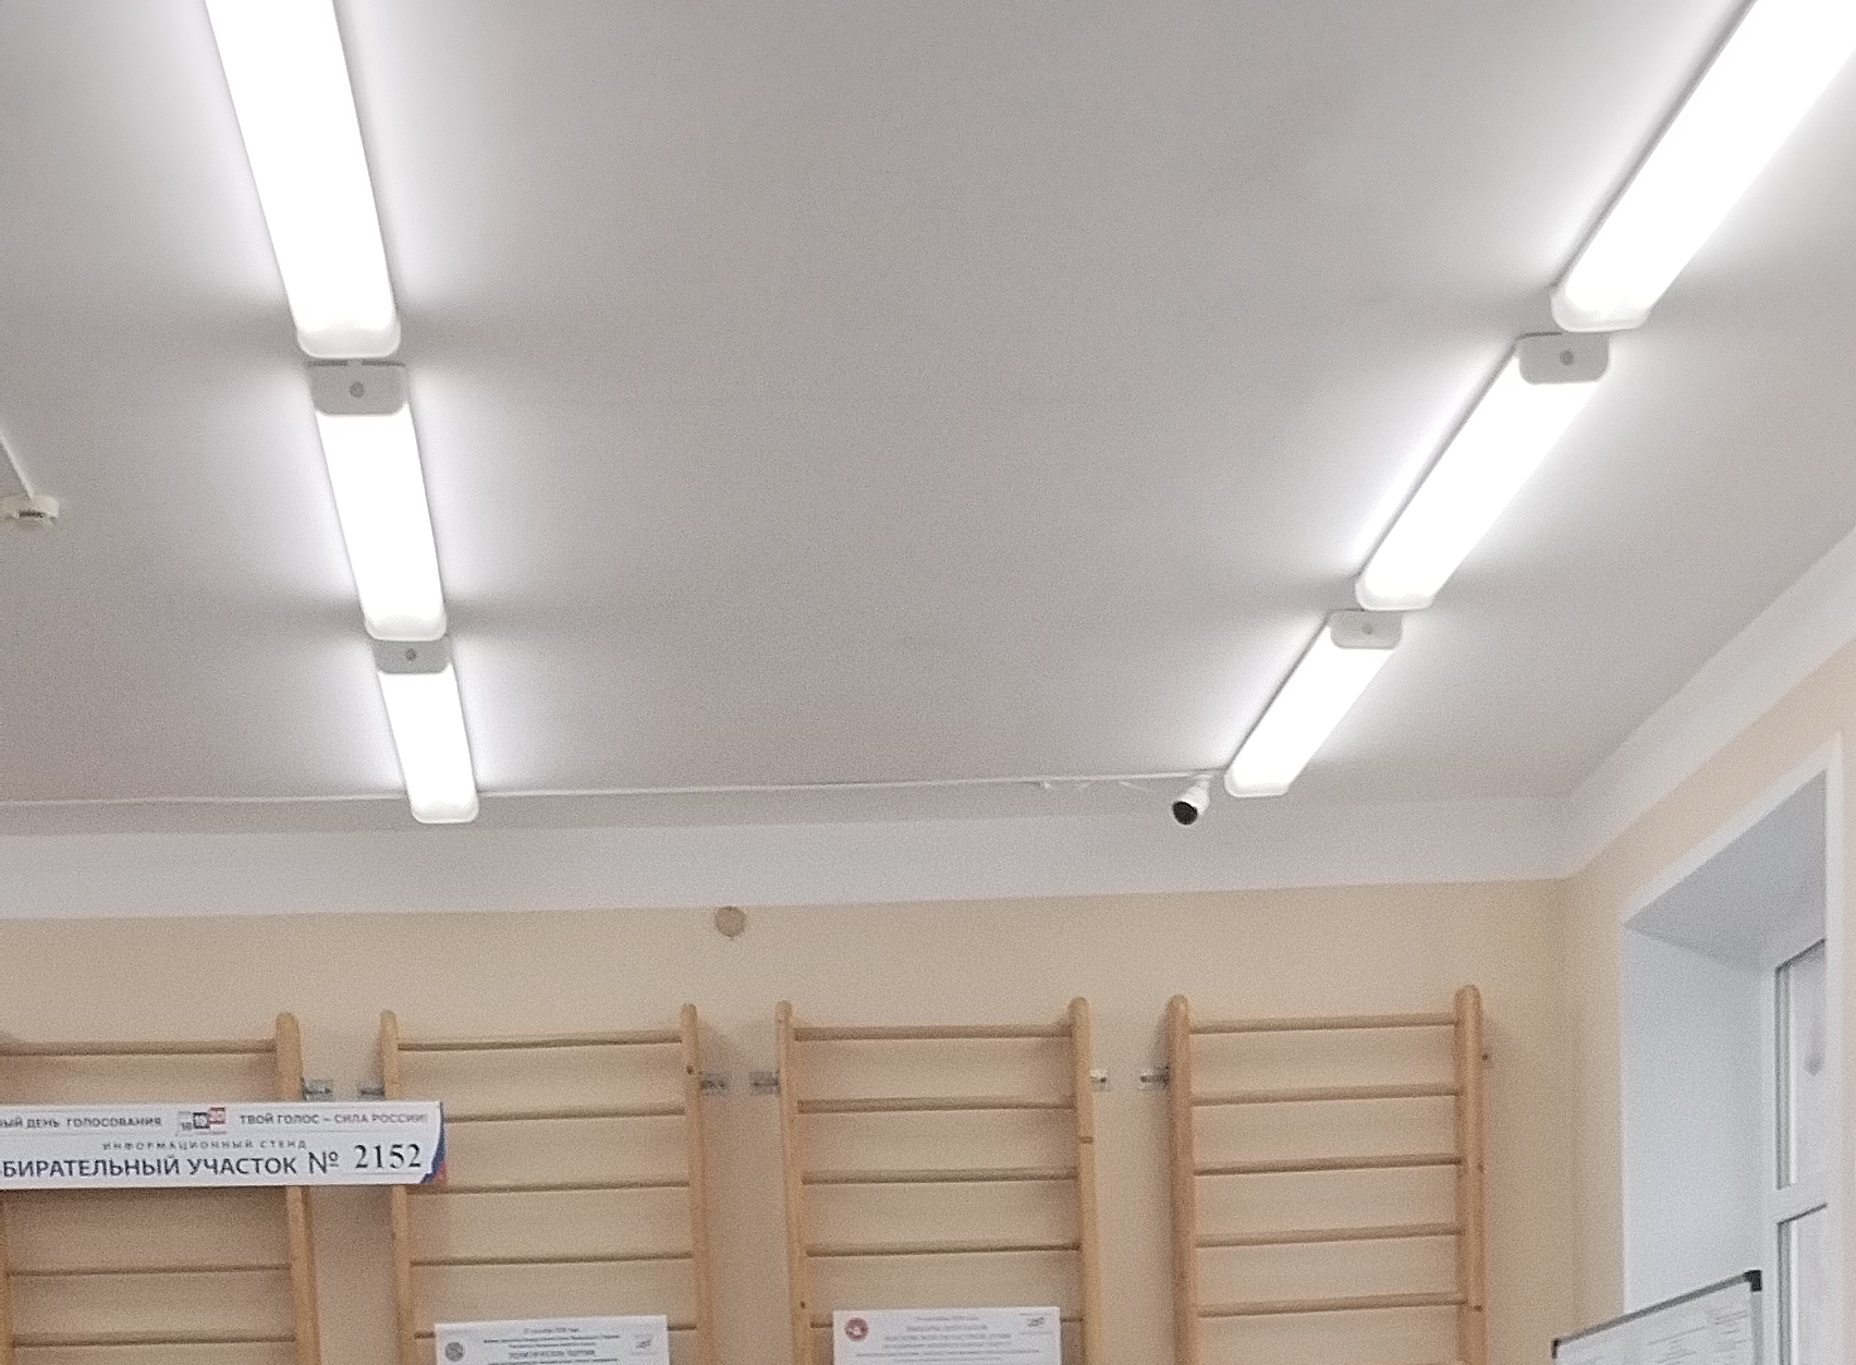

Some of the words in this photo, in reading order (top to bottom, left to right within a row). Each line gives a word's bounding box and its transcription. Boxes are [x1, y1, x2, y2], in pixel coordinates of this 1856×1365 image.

[26, 1117, 60, 1129] ДЕНЬ
[66, 1116, 162, 1128] ГОЛОСОВАНИЯ
[241, 1112, 274, 1124] ТВОЙ
[277, 1113, 319, 1124] ГОЛОС
[334, 1113, 368, 1123] СИЛА
[102, 1139, 254, 1150] ИНФОРМАЦИОННЫЙ
[260, 1139, 306, 1149] СТЕНД
[0, 1154, 180, 1178] БИРАТЕЛЬНЫЙ
[187, 1156, 297, 1175] УЧАСТОК
[308, 1150, 339, 1174] №
[354, 1143, 421, 1169] 2152
